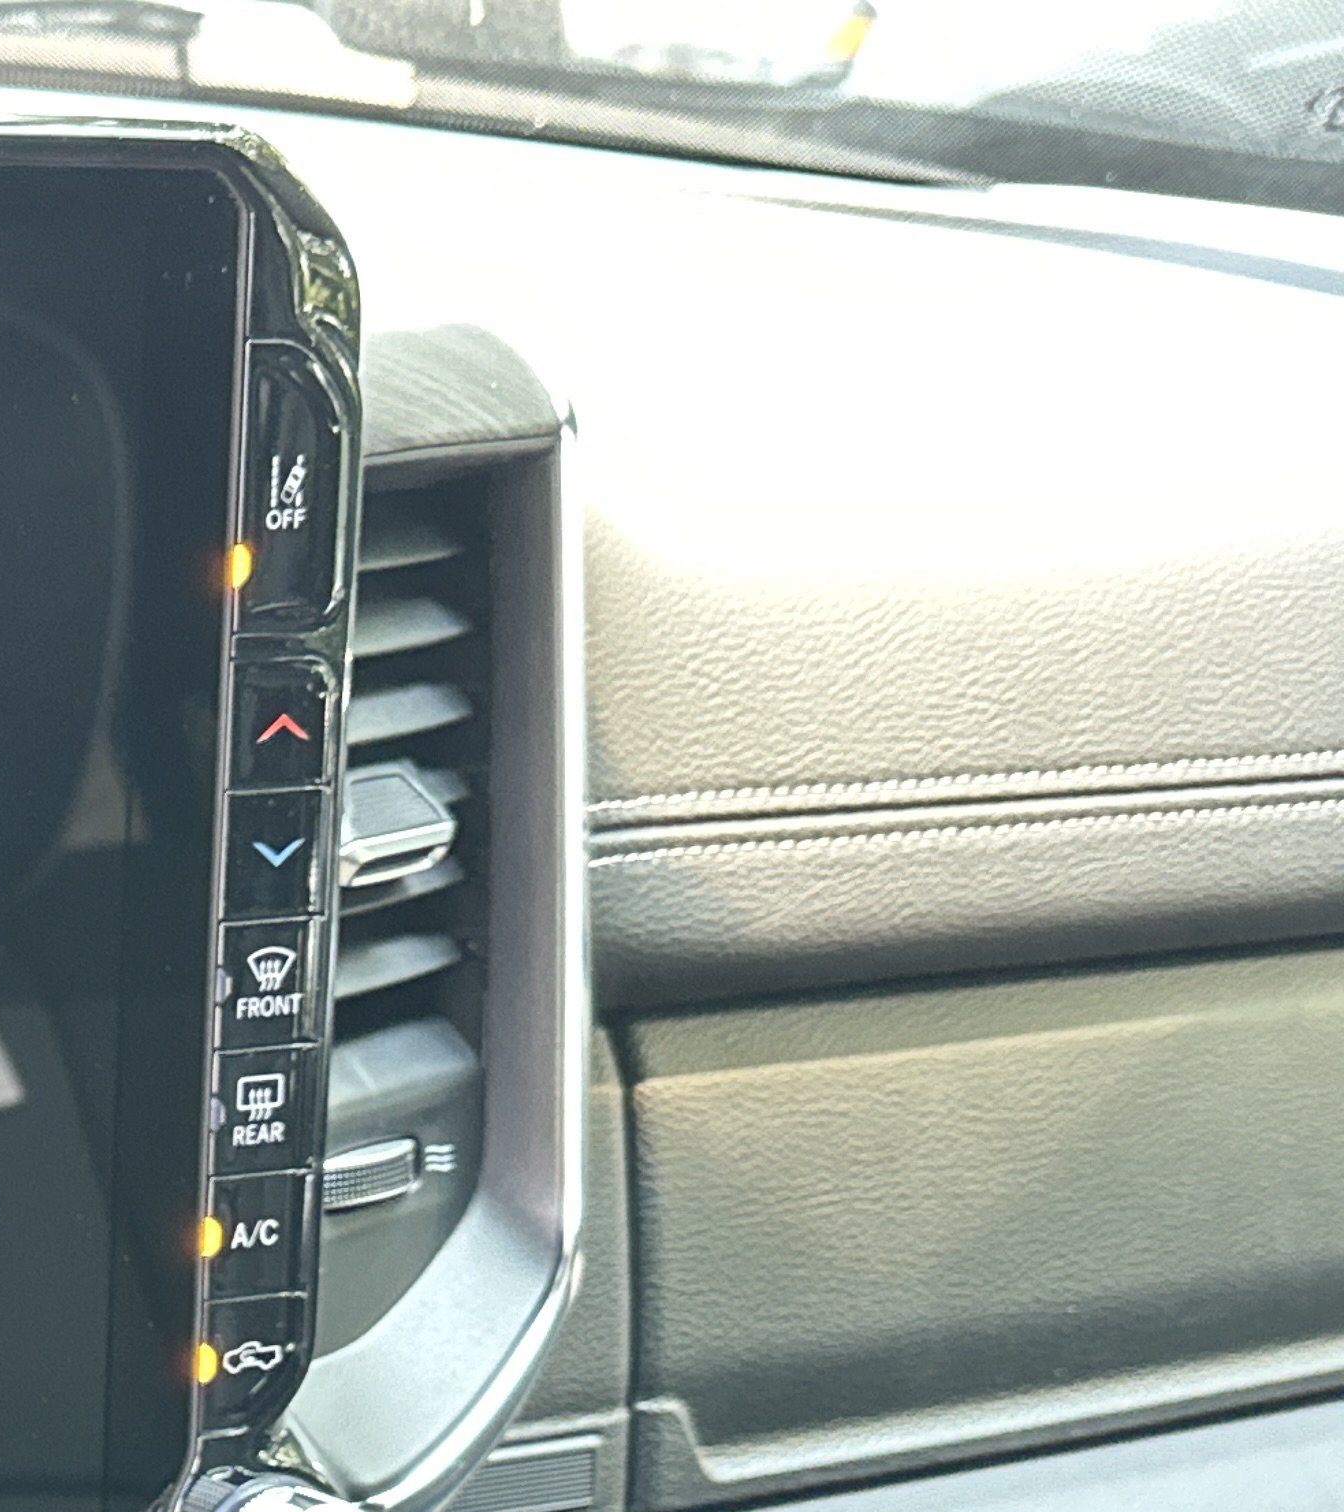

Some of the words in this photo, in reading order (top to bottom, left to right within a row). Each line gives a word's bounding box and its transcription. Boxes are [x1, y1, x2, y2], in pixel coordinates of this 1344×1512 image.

[265, 508, 308, 530] OFF
[236, 993, 303, 1020] FRONT
[232, 1122, 286, 1147] REAR
[230, 1218, 280, 1250] A/C
